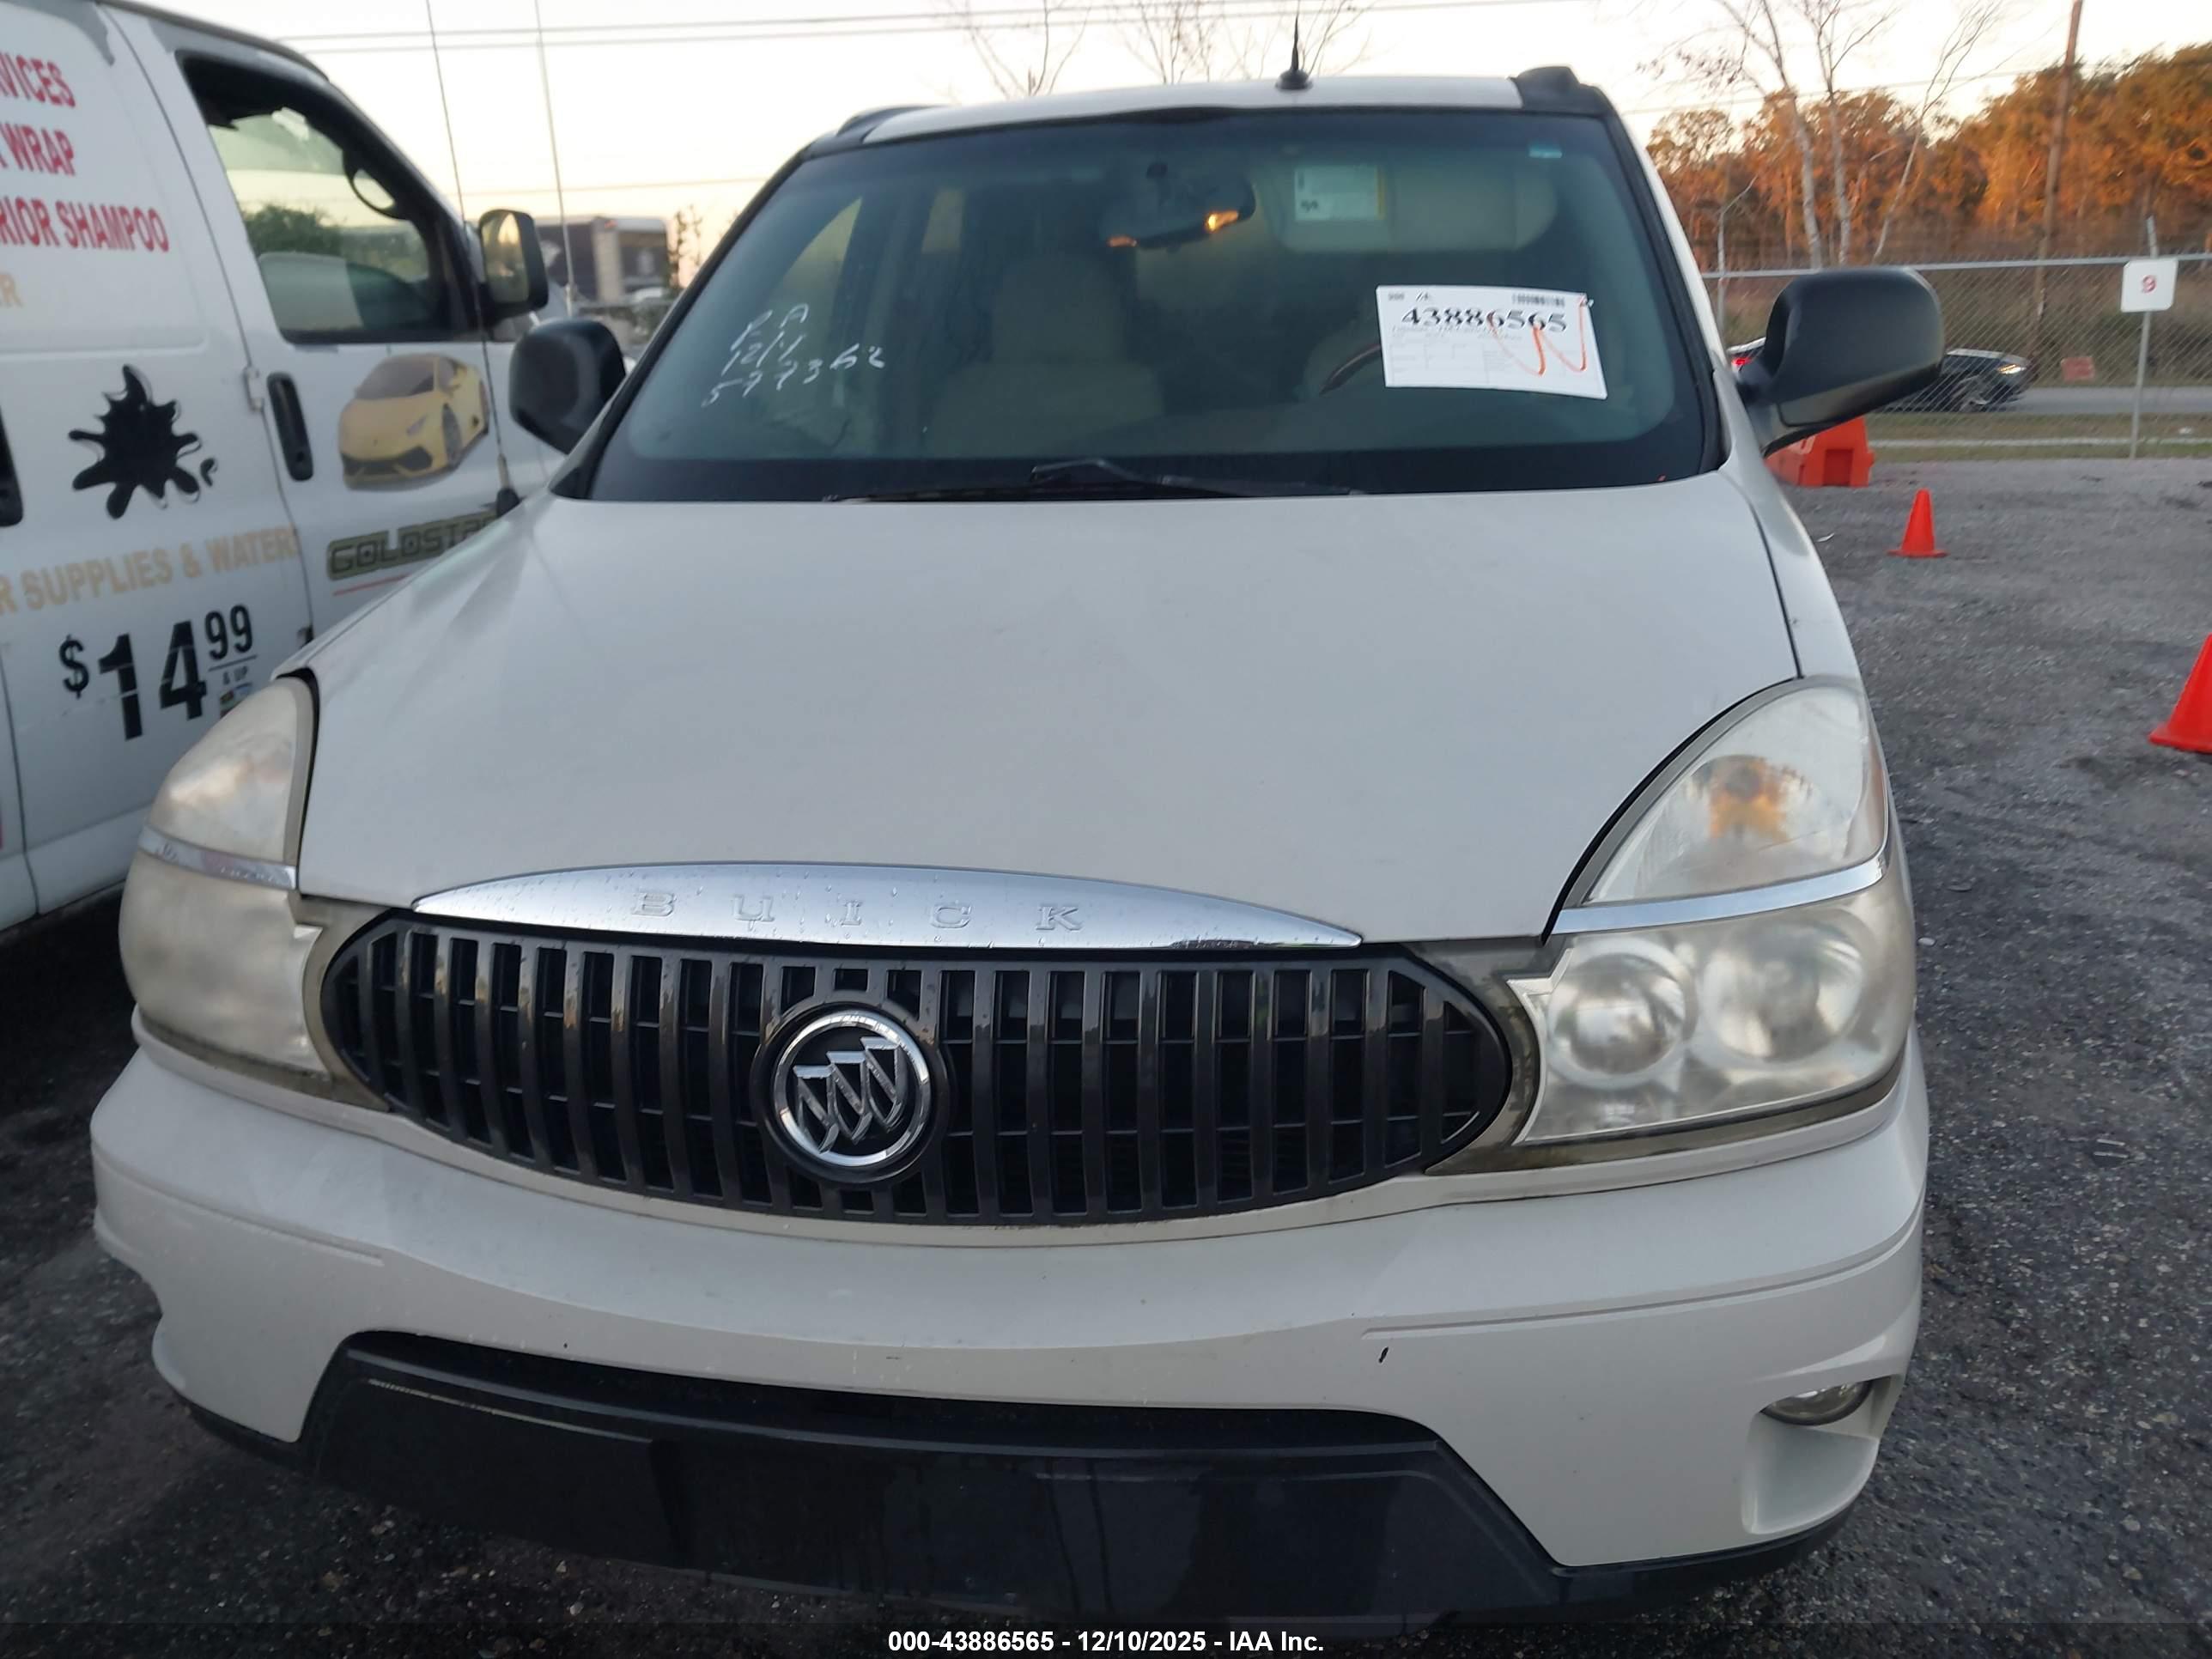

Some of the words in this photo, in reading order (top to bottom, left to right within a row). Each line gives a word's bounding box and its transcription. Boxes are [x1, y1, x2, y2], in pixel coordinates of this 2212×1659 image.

[0, 52, 76, 108] VICES
[55, 200, 169, 252] SHAMPOO
[1401, 307, 1566, 332] 43886565
[20, 547, 173, 611] SUPPLIES
[179, 542, 203, 578] &
[630, 891, 1083, 932] BUICK
